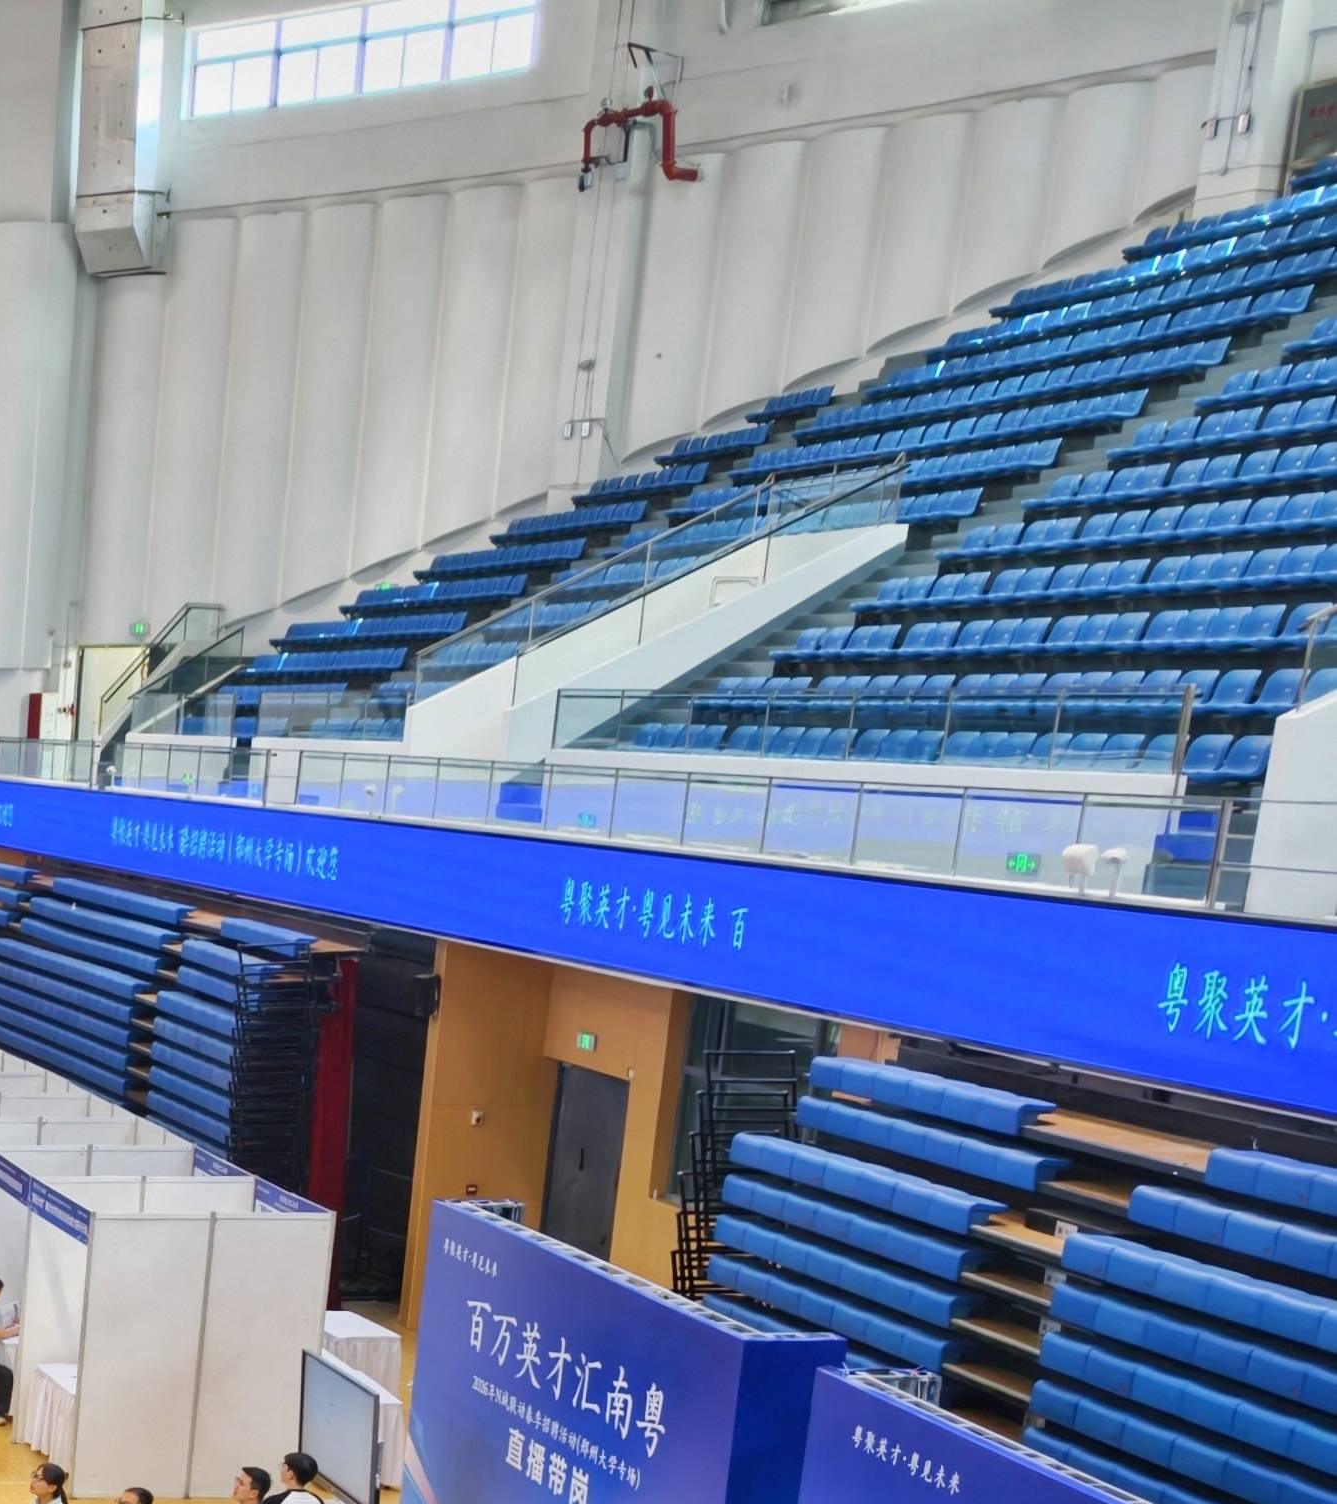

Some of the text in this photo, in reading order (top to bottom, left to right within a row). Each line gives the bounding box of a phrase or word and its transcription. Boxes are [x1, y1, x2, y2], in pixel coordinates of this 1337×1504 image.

[731, 907, 749, 950] 百
[1158, 962, 1337, 1050] 粤聚英才·
[466, 1299, 666, 1458] 百万英才汇南粤
[852, 1423, 962, 1496] 粤聚英才·粤见未来
